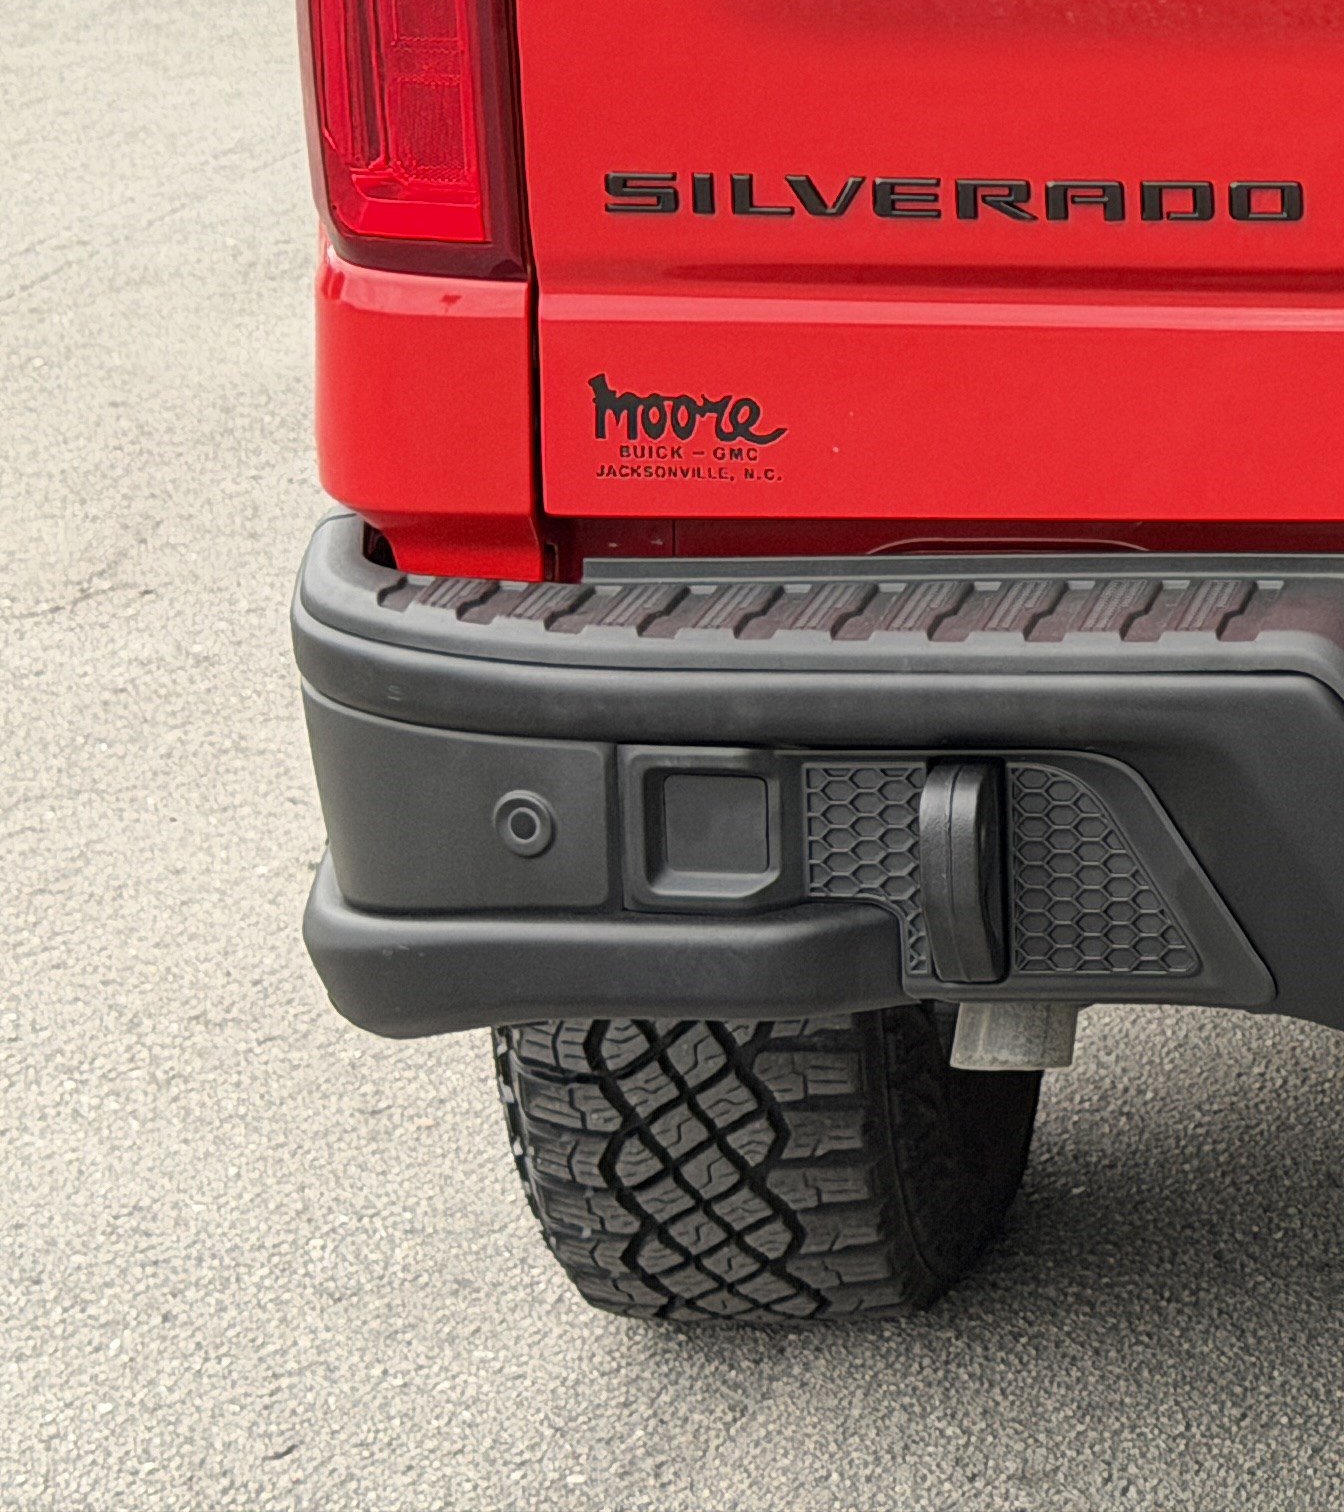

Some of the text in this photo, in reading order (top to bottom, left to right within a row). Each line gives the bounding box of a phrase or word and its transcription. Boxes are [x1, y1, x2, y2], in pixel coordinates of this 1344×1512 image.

[604, 171, 1304, 223] SILVERADO
[619, 445, 683, 459] BUICK
[712, 446, 759, 461] GMC
[596, 464, 783, 482] JACKSONVILLE, N.C.
